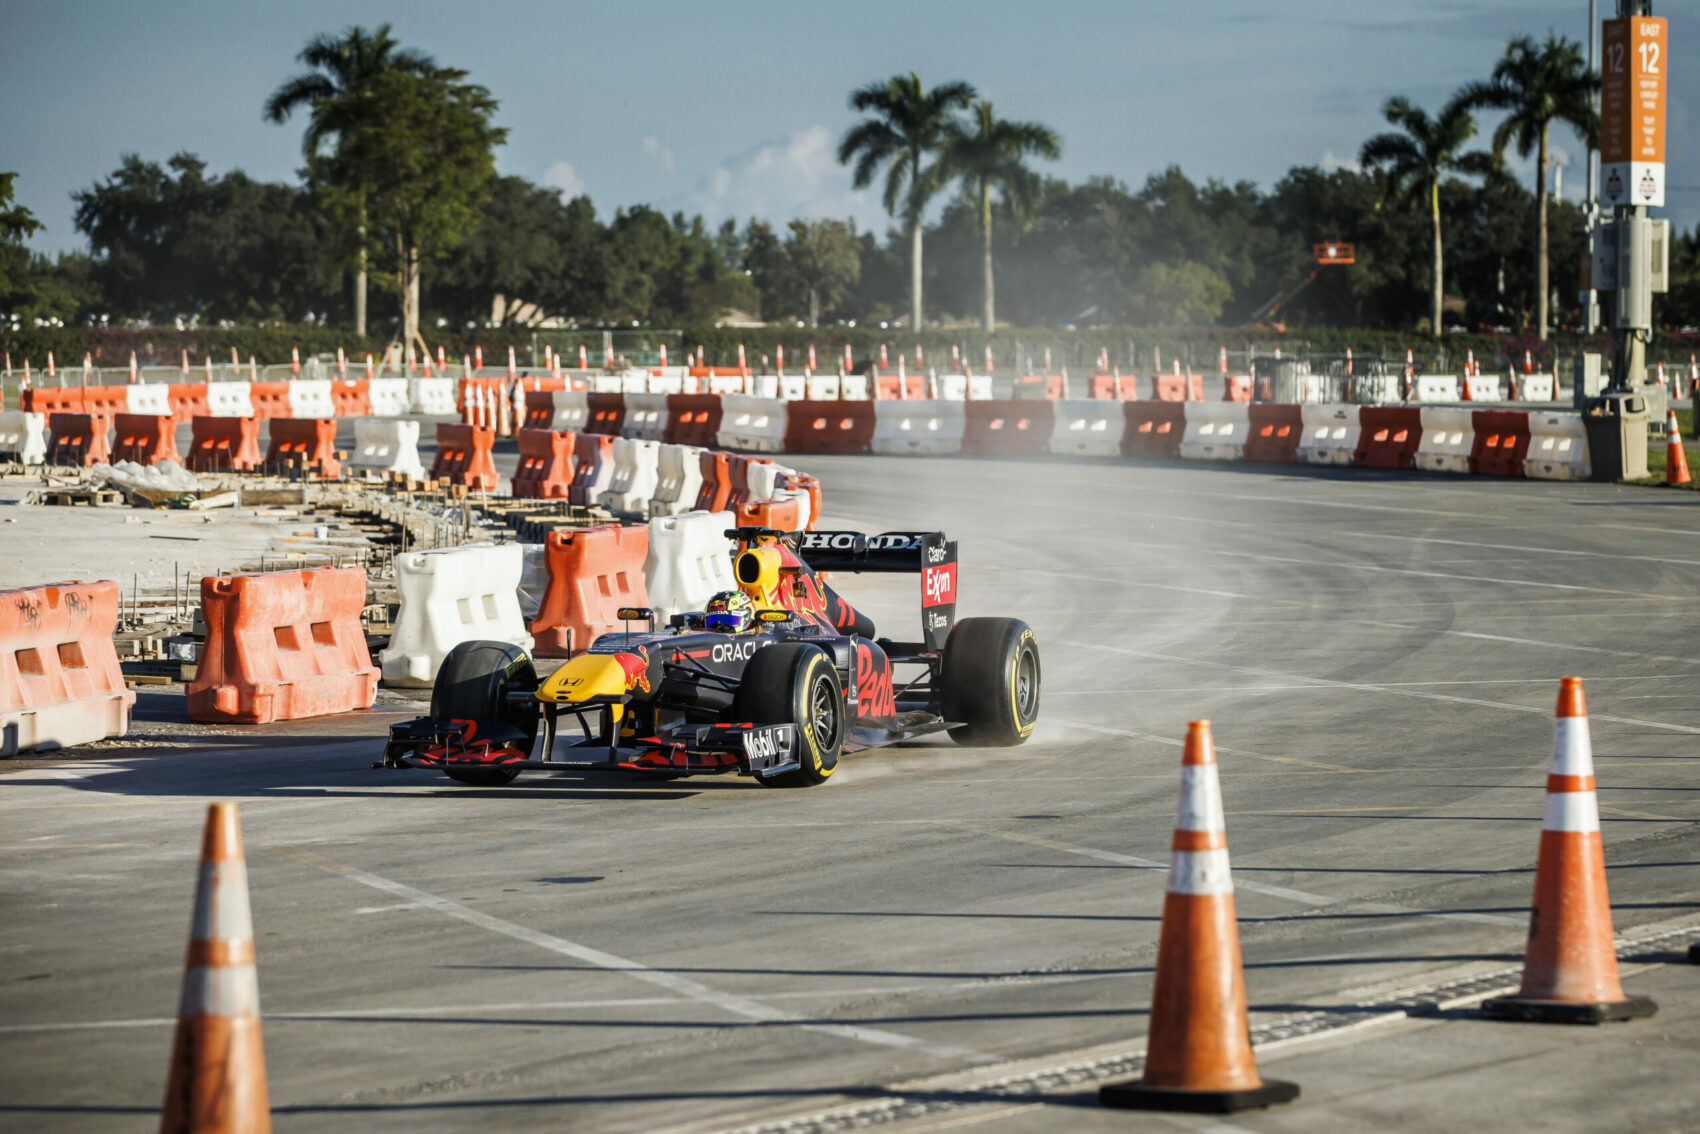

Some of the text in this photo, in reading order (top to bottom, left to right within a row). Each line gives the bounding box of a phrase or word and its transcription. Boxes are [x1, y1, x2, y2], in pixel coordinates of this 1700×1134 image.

[1640, 23, 1660, 37] EAST
[1607, 43, 1624, 72] 12
[1638, 42, 1660, 73] 12
[801, 534, 922, 550] HONDA
[927, 568, 950, 603] Exxon
[837, 597, 855, 627] 11
[713, 641, 772, 662] ORACL
[743, 728, 776, 759] Mobil
